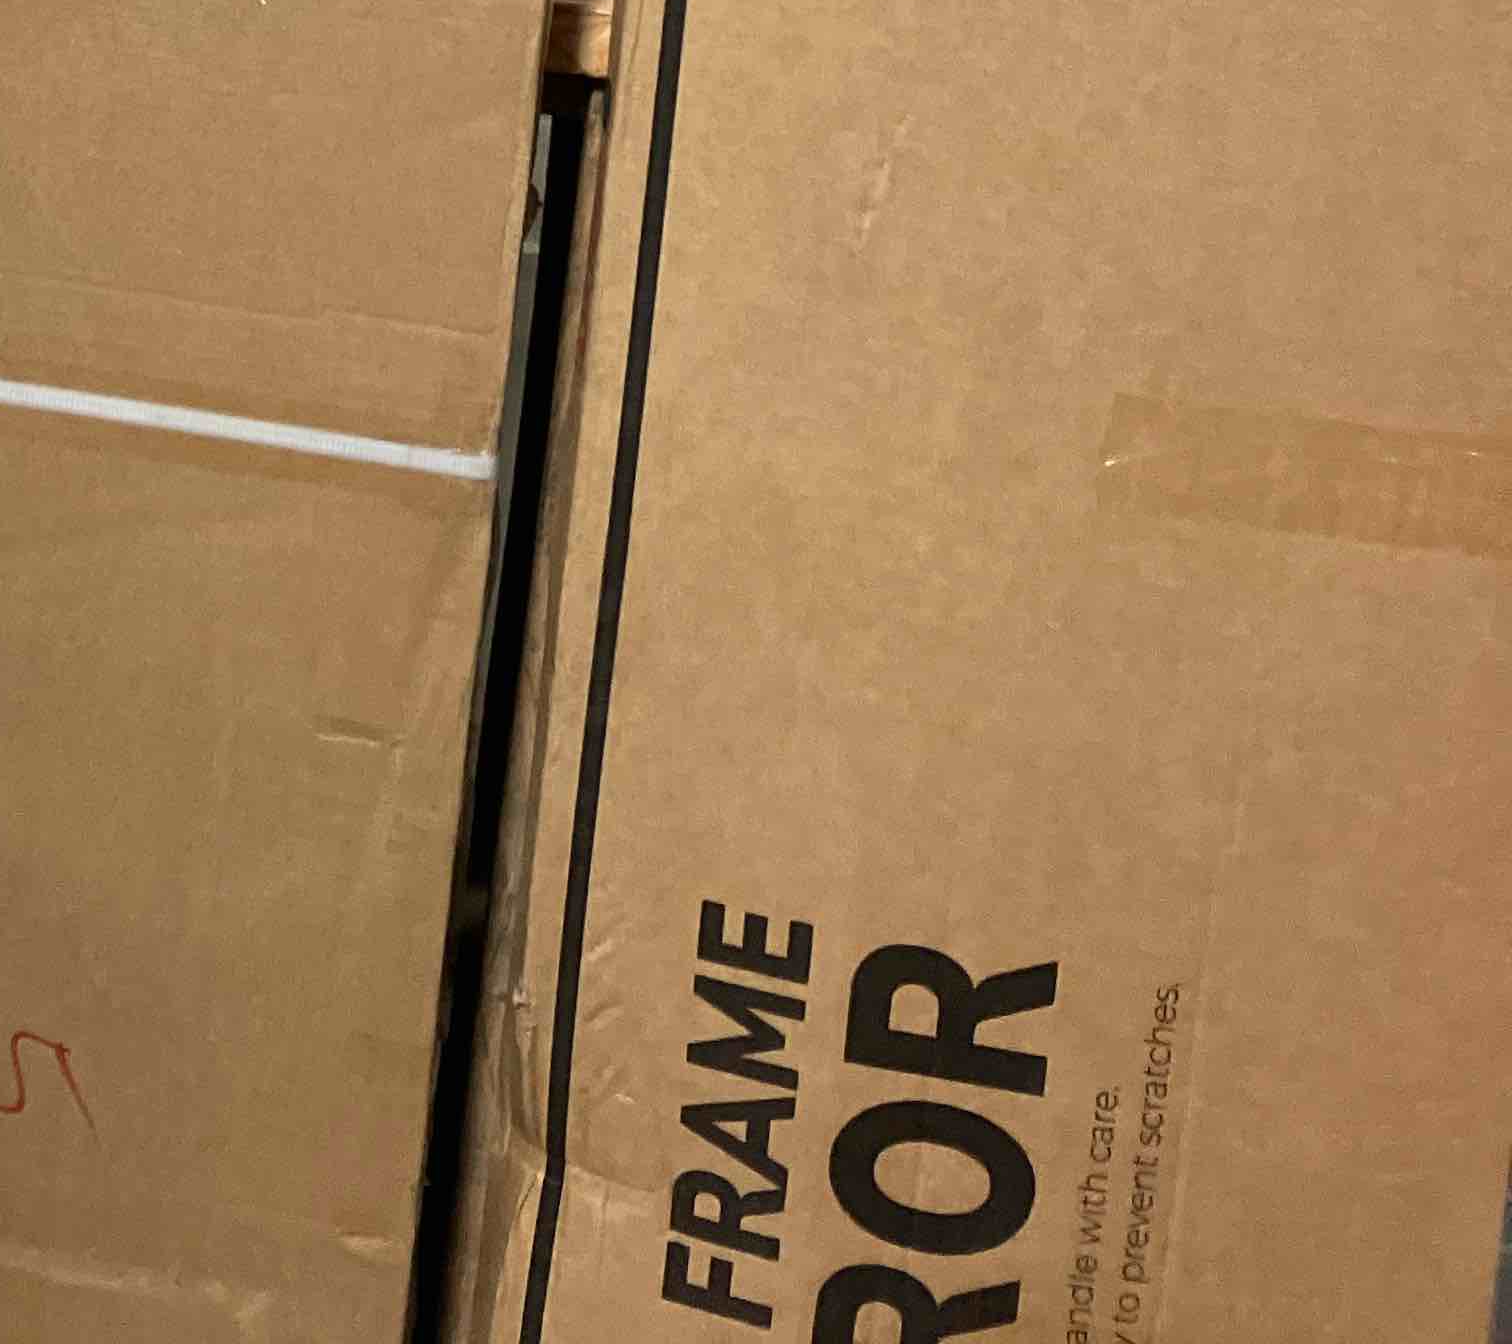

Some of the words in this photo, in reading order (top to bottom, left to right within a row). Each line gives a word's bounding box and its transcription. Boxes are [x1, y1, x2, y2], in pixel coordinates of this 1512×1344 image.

[661, 898, 814, 1330] FRAME
[1078, 1174, 1108, 1244] with
[1121, 1155, 1158, 1284] prevent
[1114, 1293, 1141, 1324] to
